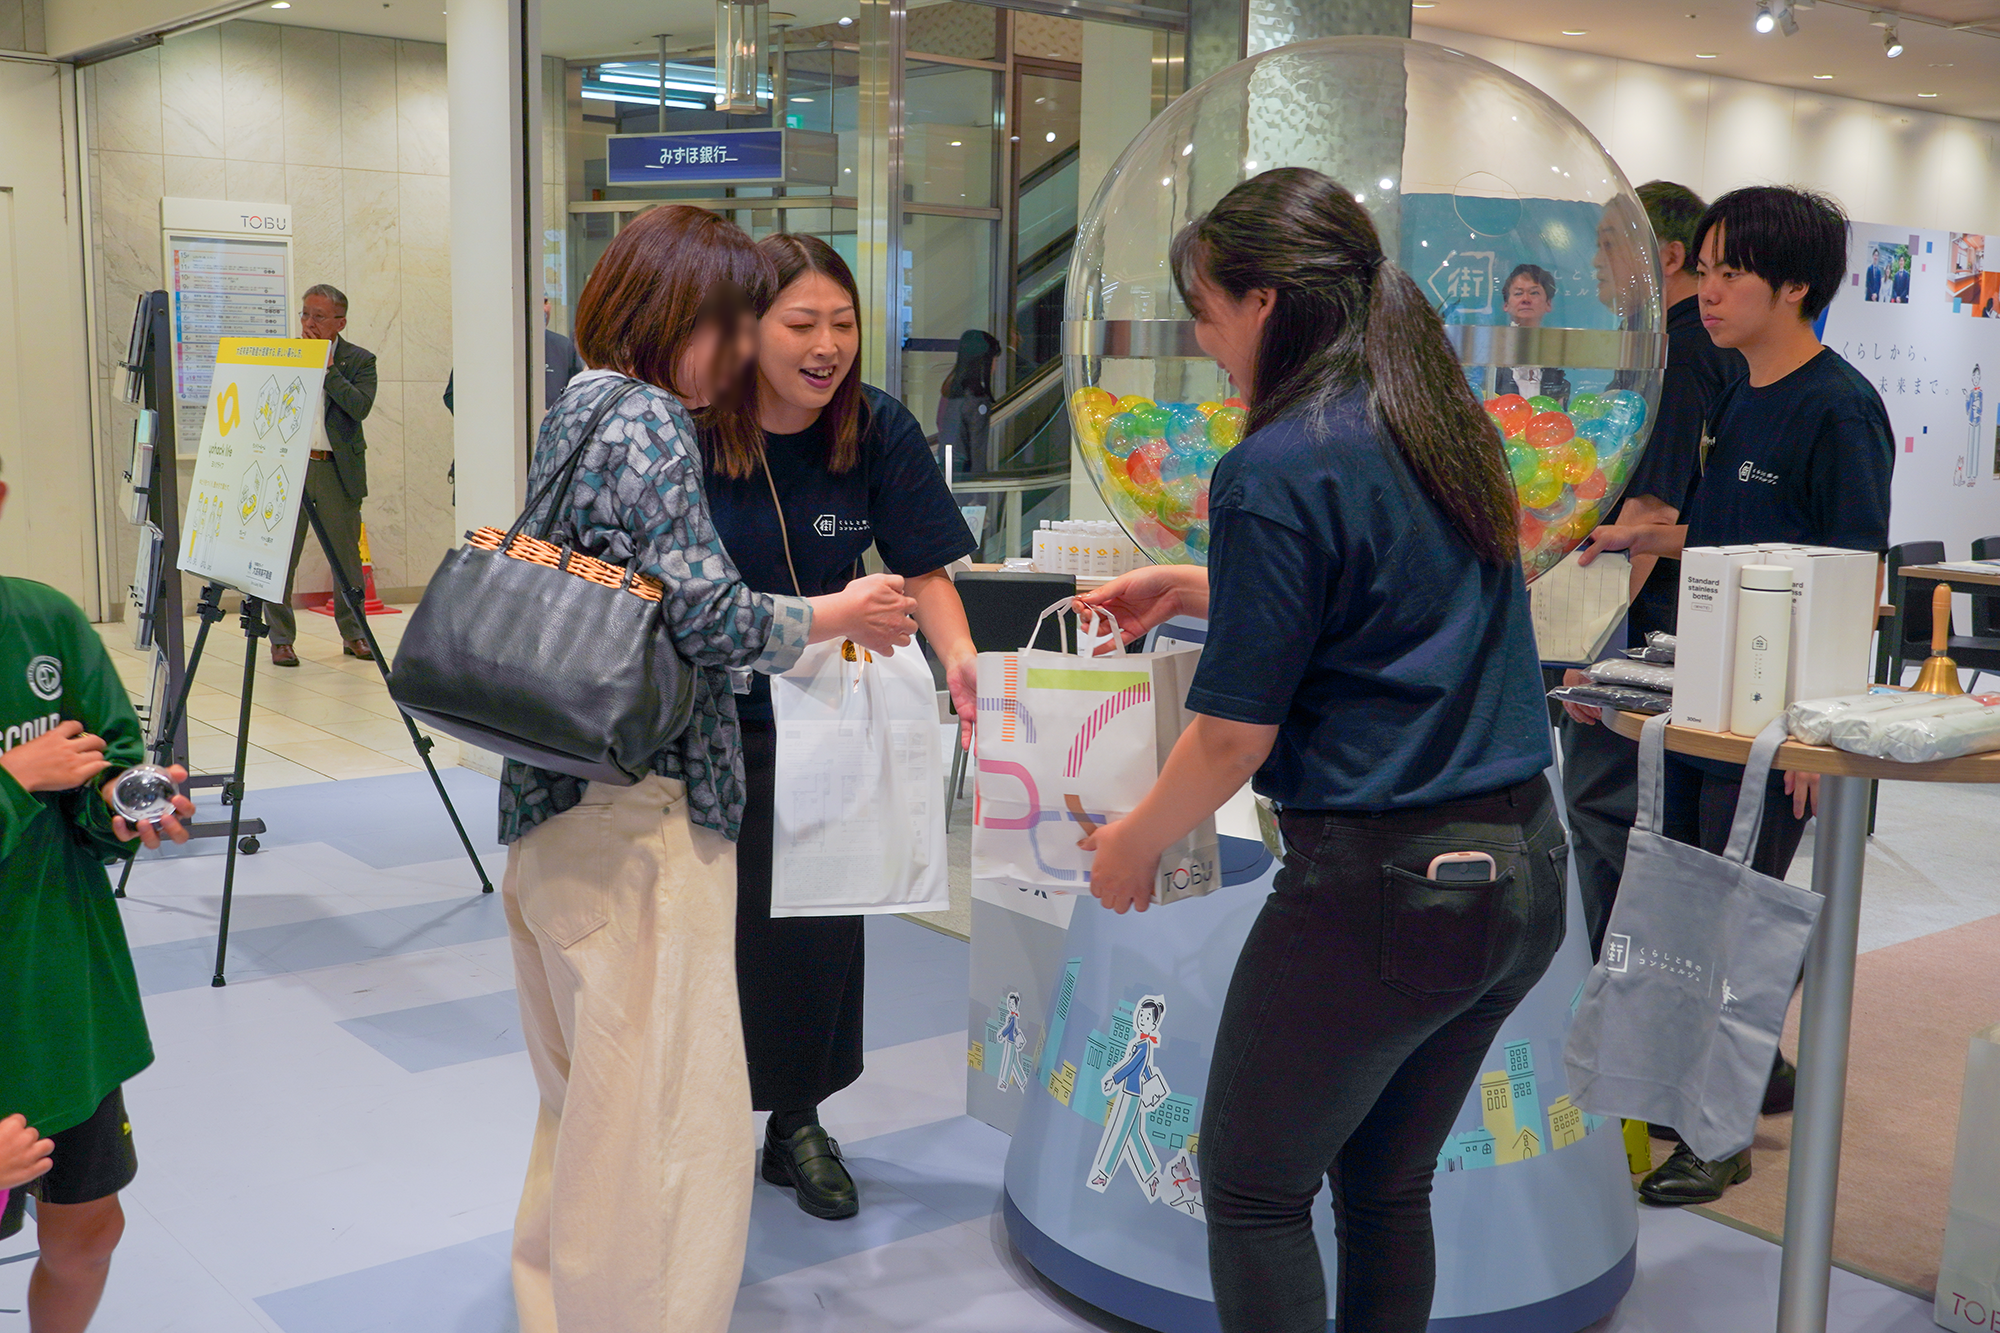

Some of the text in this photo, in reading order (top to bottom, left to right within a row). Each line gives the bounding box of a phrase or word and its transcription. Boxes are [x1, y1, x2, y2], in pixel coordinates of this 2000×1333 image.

[660, 145, 727, 165] みずほ銀行
[240, 215, 286, 231] TOBU
[1447, 266, 1484, 297] 街
[1842, 341, 1927, 361] くらしから、
[1878, 376, 1949, 396] 未来まで。
[1687, 576, 1720, 586] Standard
[1688, 584, 1719, 594] stainless
[1692, 593, 1713, 601] bottle
[1164, 860, 1213, 892] TOBU
